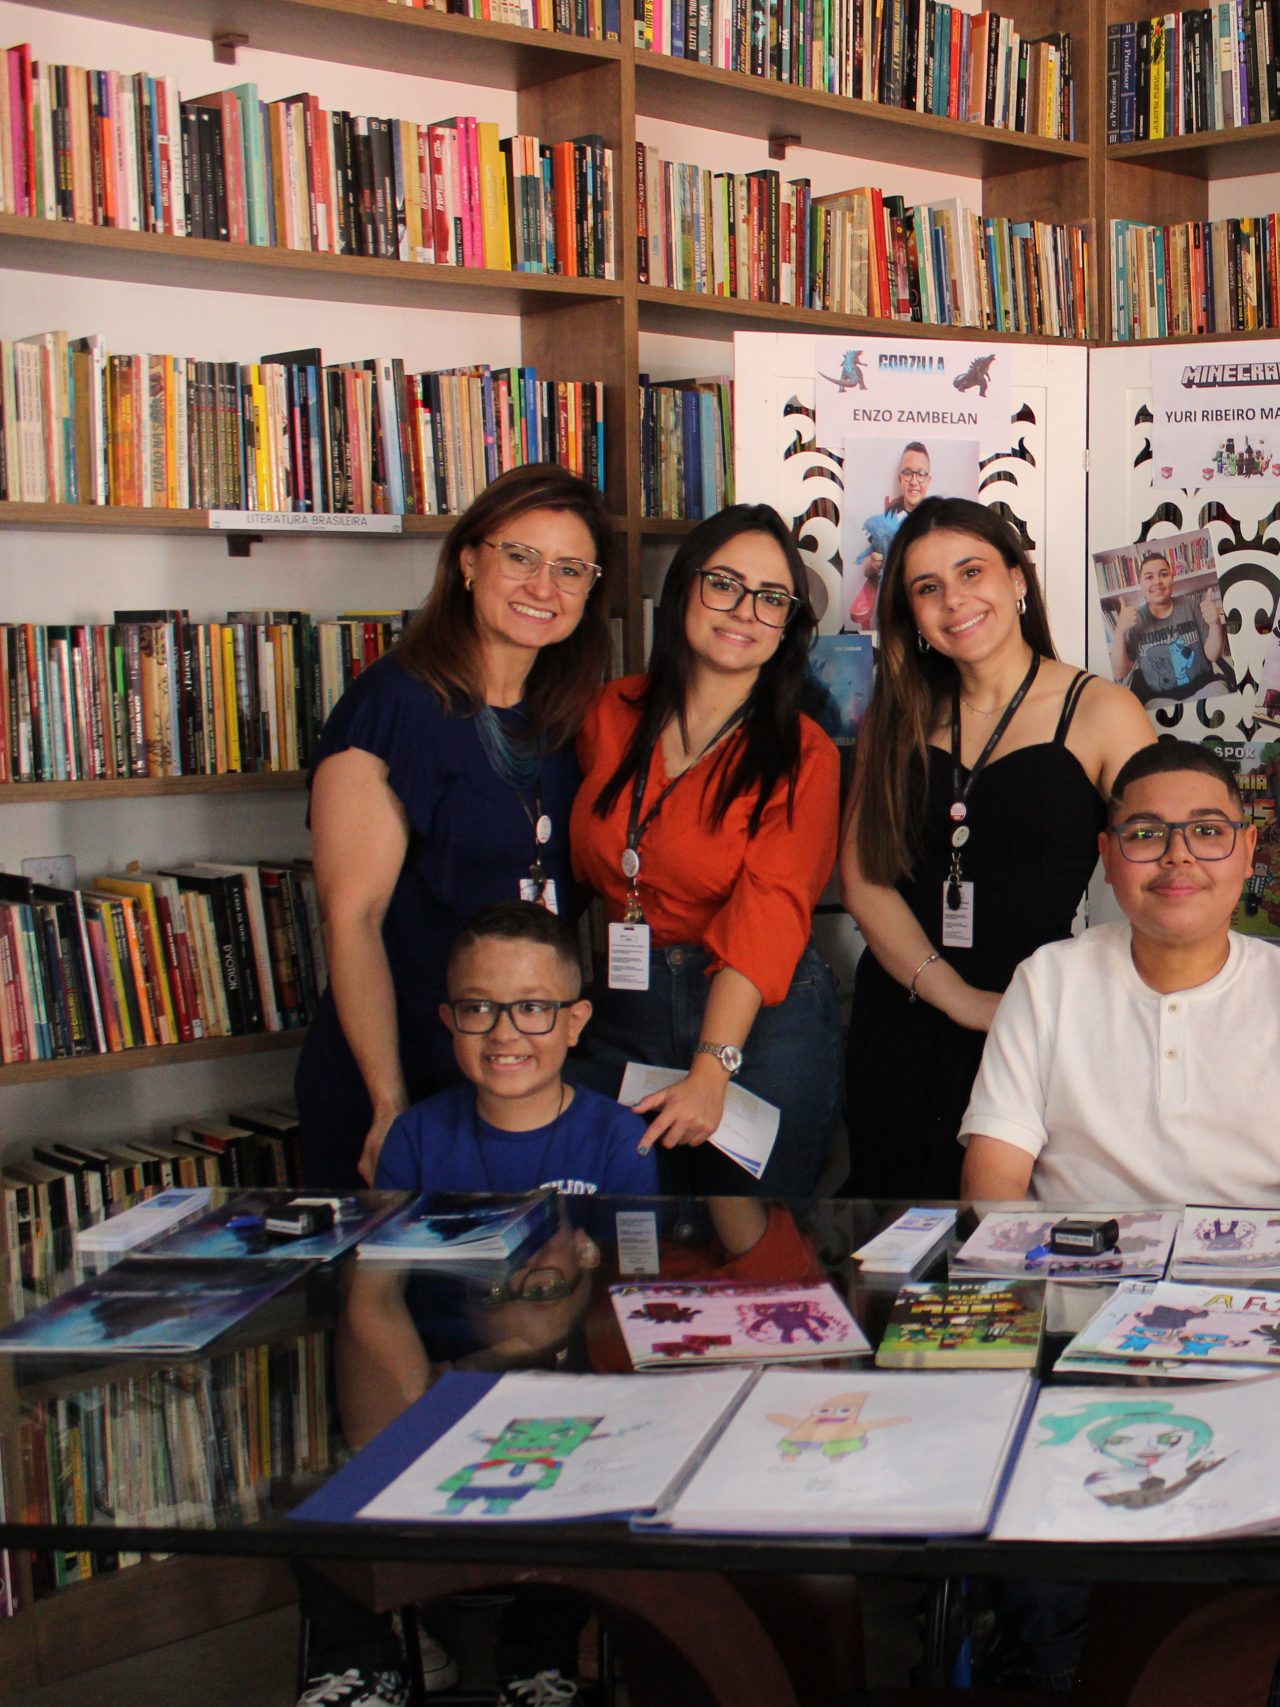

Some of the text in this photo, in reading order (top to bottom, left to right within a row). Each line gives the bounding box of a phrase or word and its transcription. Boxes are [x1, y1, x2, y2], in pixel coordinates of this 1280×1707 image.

[700, 5, 708, 26] EMA
[781, 29, 790, 50] EMA
[878, 354, 945, 372] GODZILLA
[853, 408, 978, 426] ENZO ZAMBELAN
[1166, 410, 1198, 424] YURI
[1202, 408, 1256, 423] RIBEIRO
[246, 514, 368, 526] LITERATURA BRASILEIRA
[1204, 1295, 1233, 1312] A
